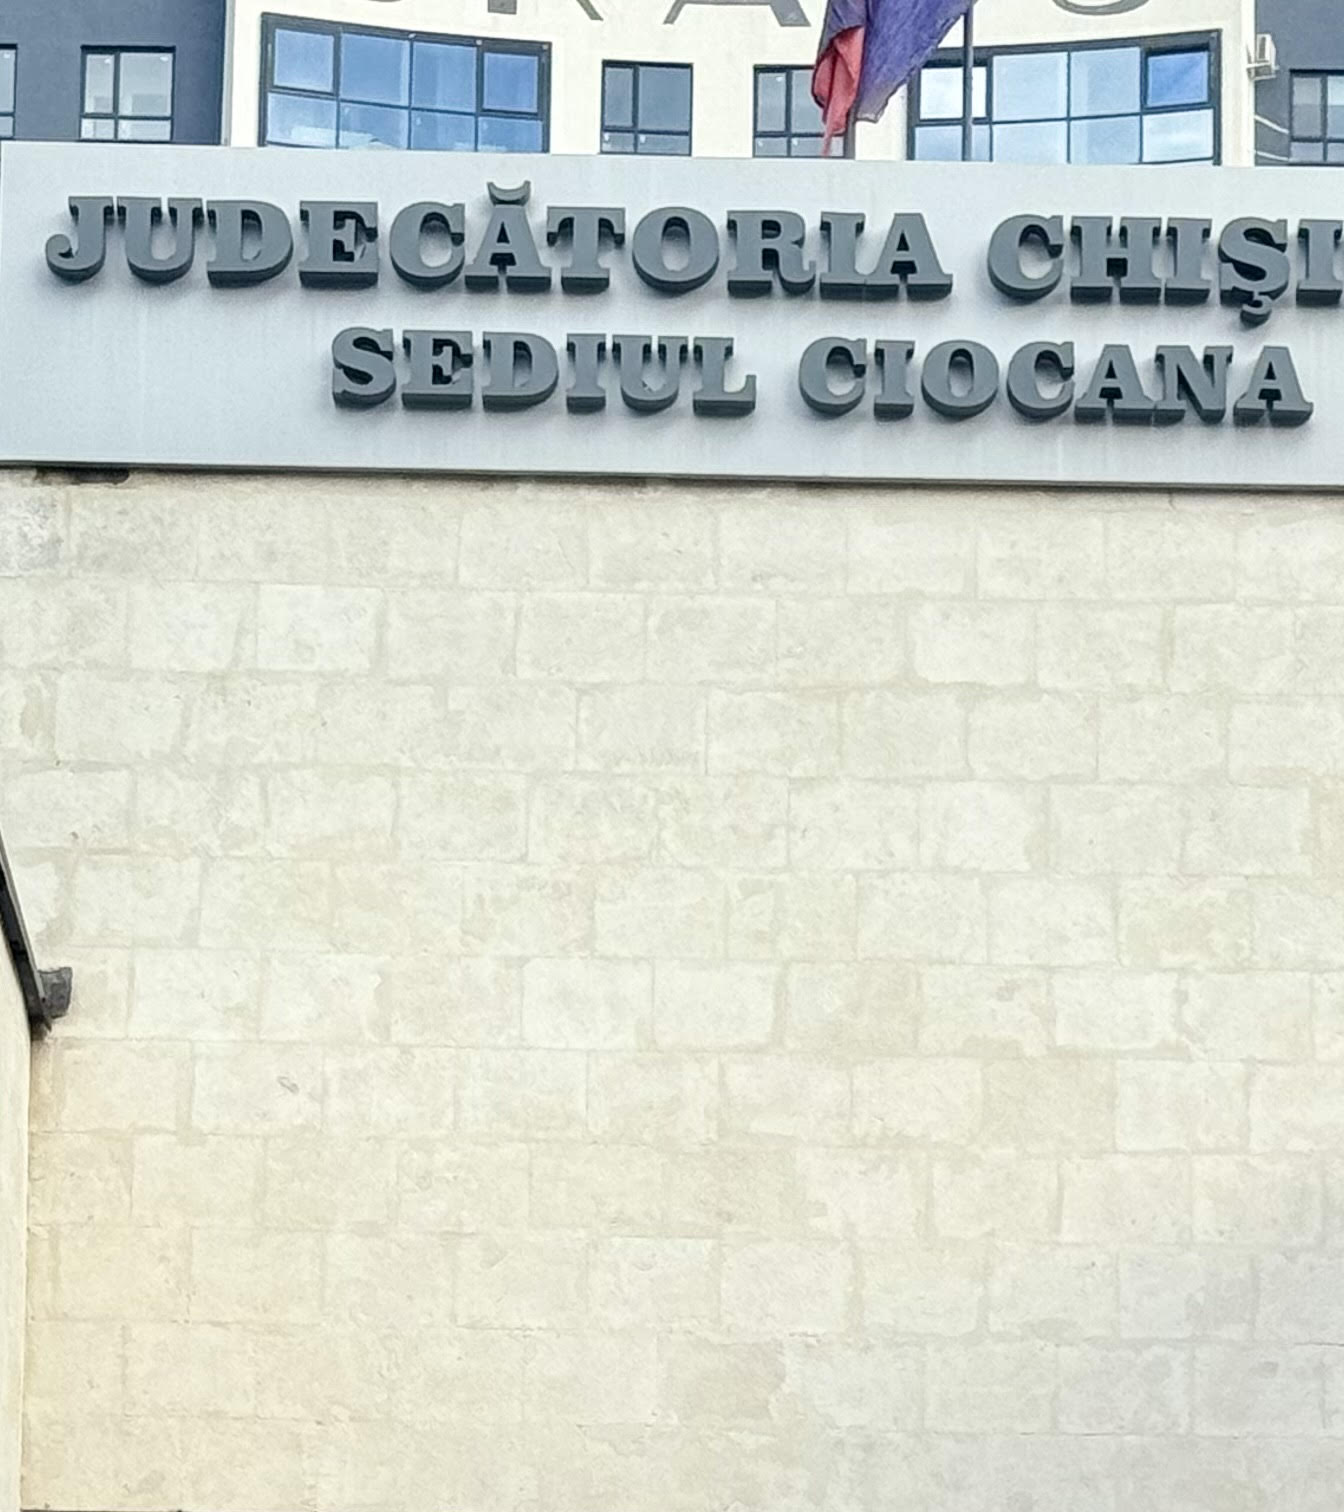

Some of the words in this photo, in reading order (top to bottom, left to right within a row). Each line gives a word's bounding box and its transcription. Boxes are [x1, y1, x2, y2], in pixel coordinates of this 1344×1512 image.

[45, 180, 952, 299] JUDECĂTORIA
[331, 326, 756, 416] SEDIUL
[798, 336, 1313, 426] CIOCANA
